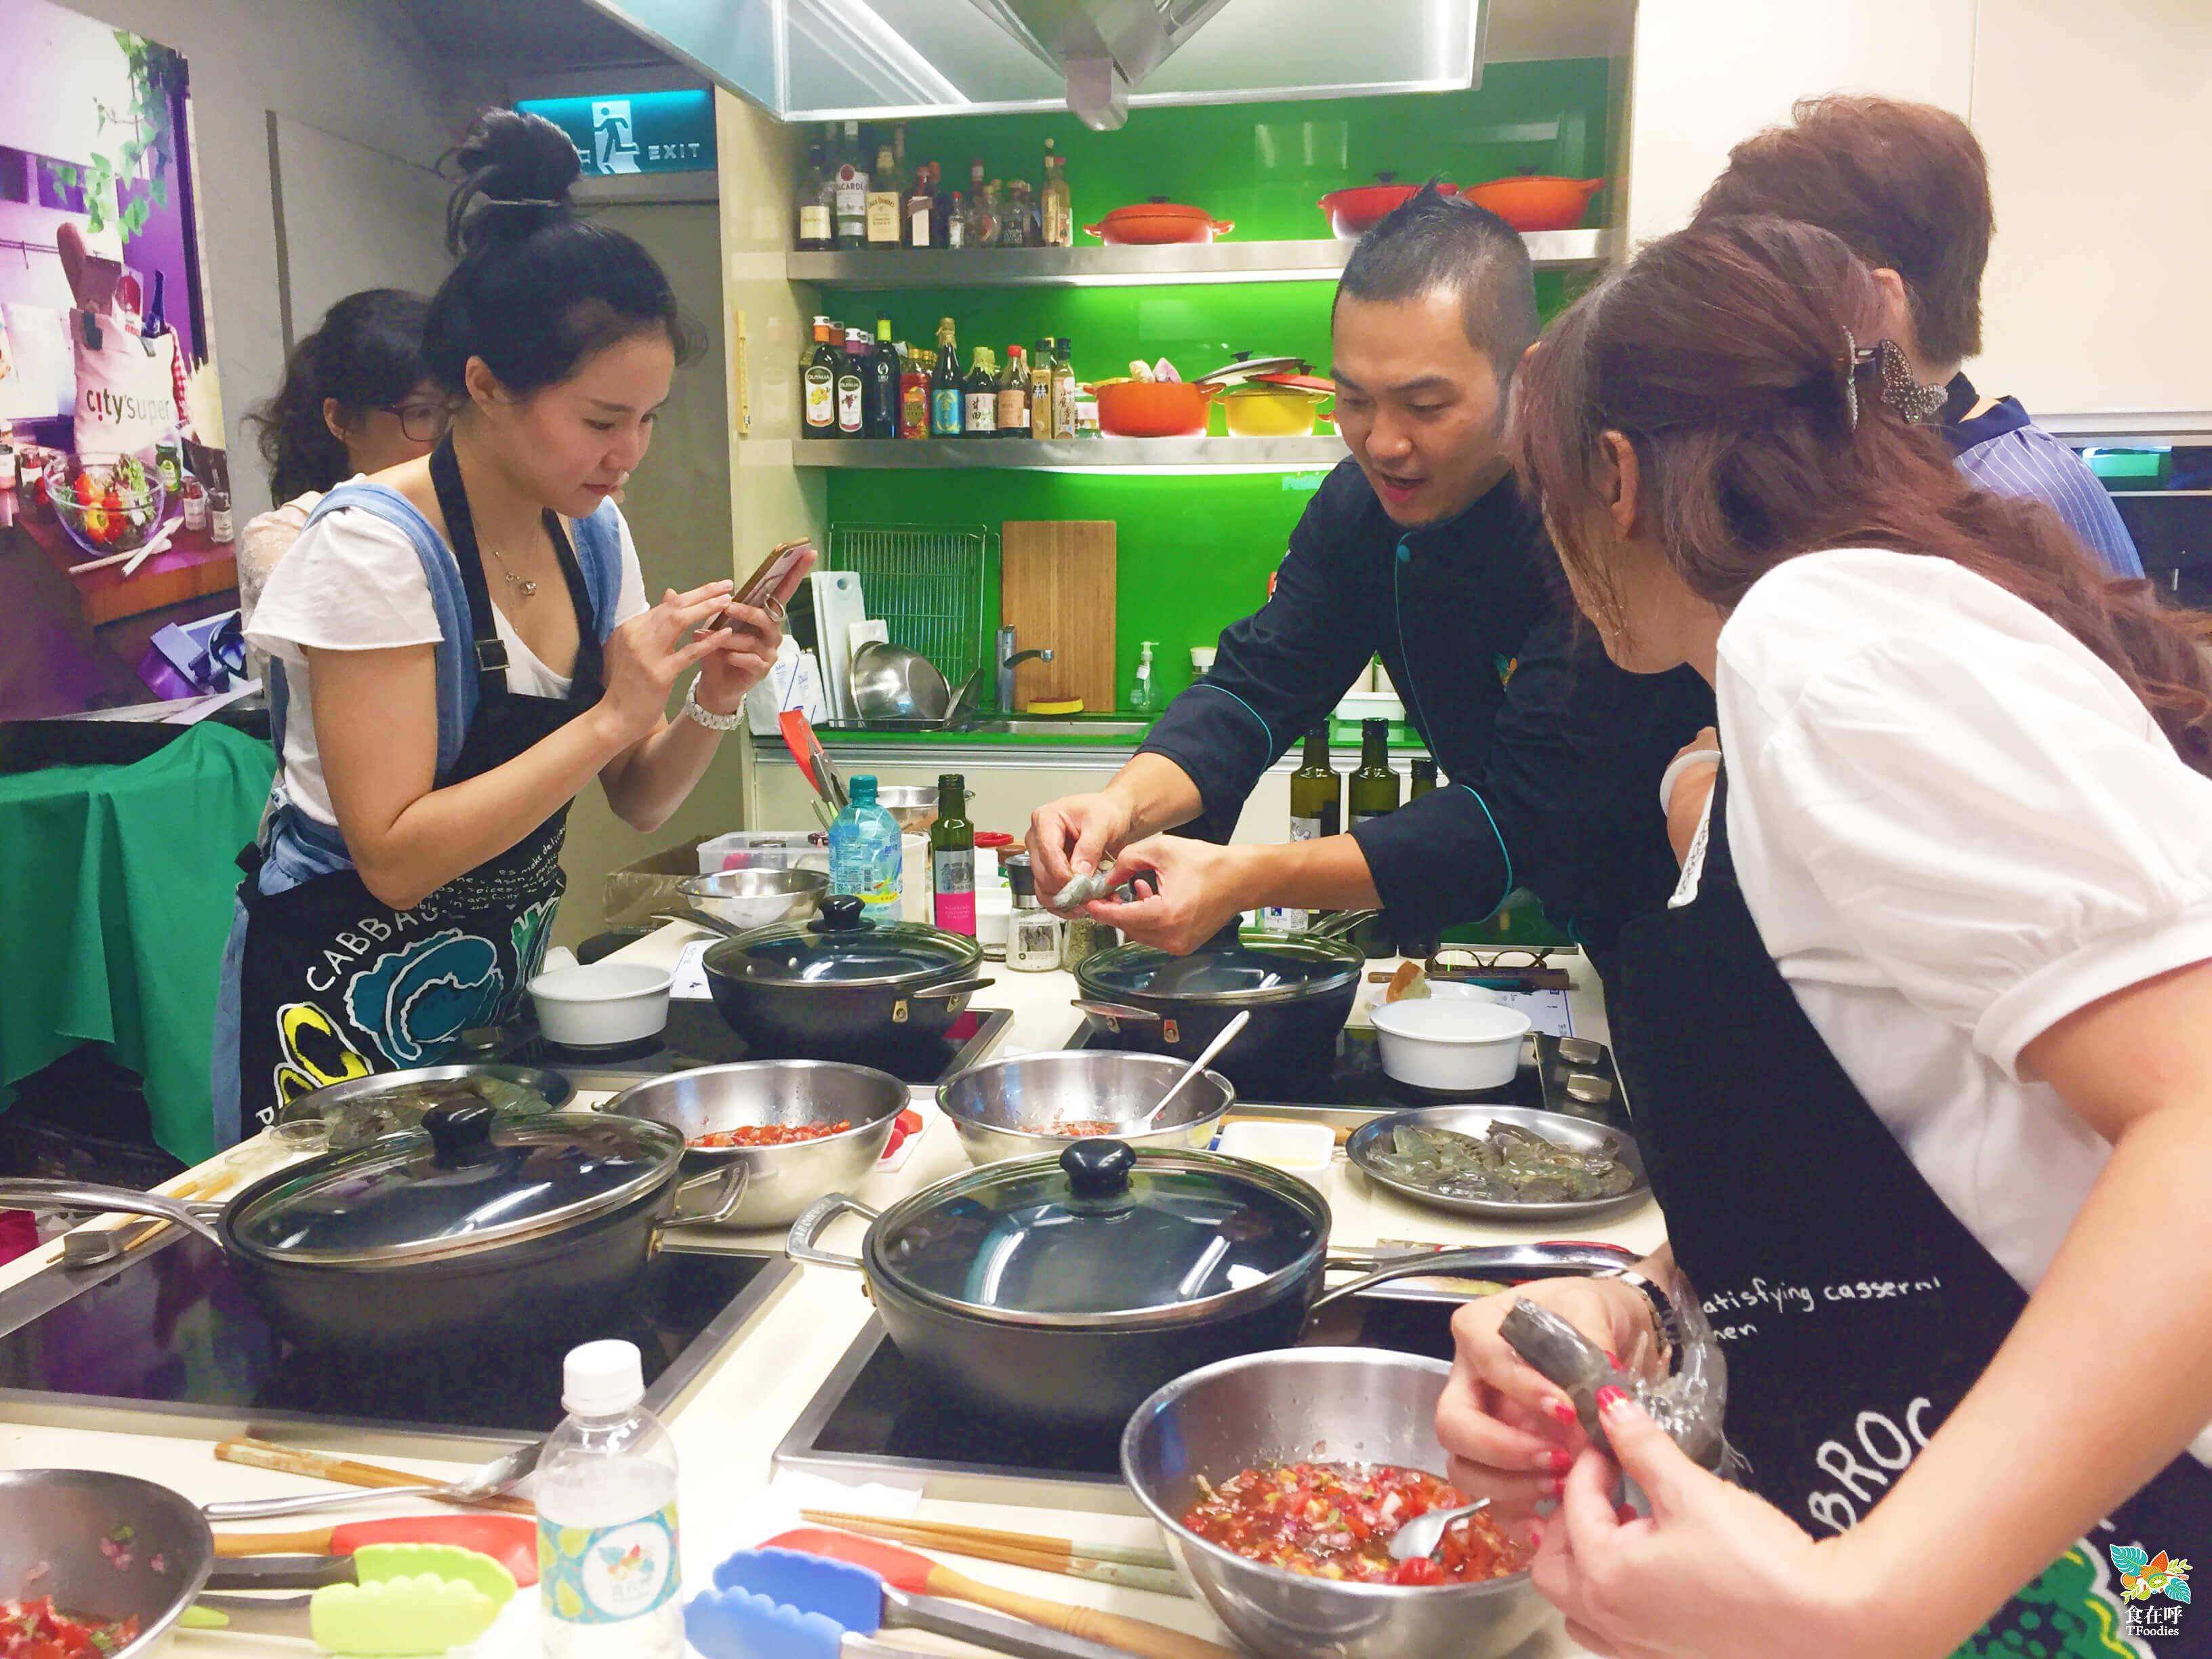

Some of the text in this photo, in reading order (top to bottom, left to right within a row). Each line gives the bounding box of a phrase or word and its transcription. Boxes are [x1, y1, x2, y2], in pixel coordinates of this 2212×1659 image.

[648, 142, 700, 161] EXIT
[521, 855, 542, 874] make
[1702, 1277, 1816, 1313] atisfying
